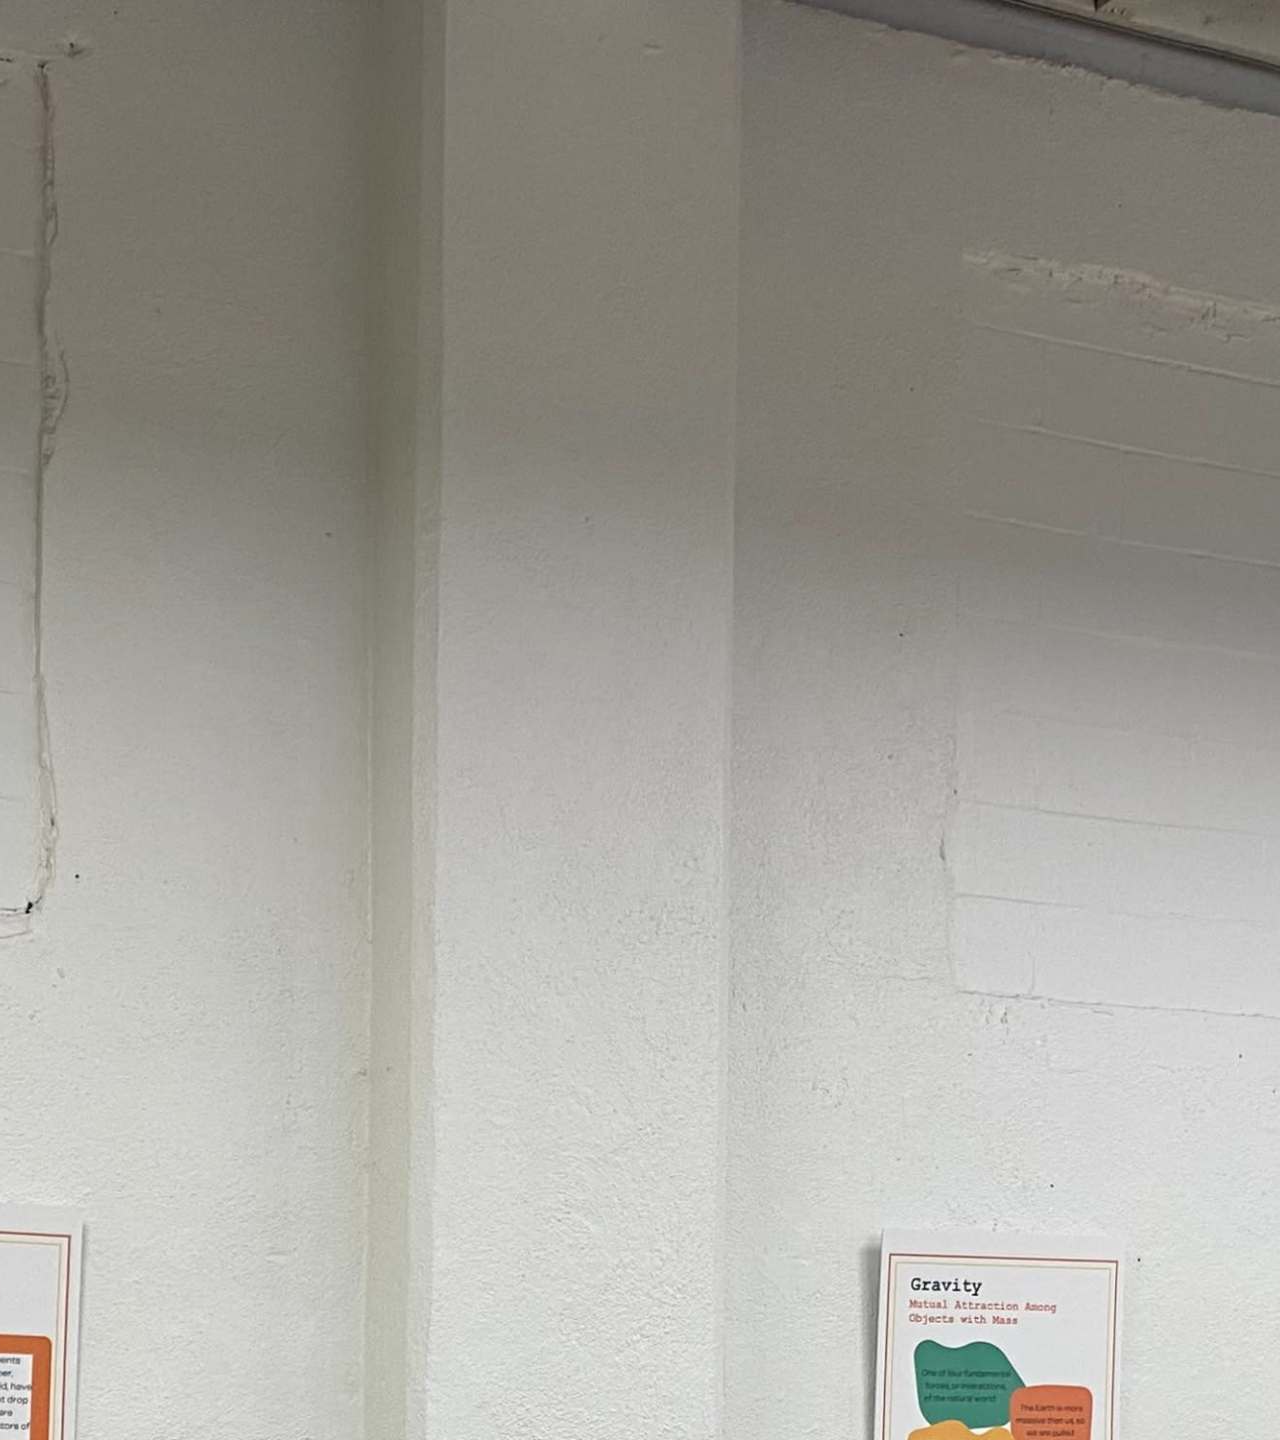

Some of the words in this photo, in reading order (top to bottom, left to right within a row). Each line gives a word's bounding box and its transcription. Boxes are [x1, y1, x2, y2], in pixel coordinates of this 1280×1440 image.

[910, 1277, 982, 1296] Gravity
[909, 1300, 947, 1310] Mutual
[955, 1301, 1019, 1311] Attraction
[1025, 1303, 1057, 1314] Among
[909, 1314, 954, 1324] Objects
[960, 1315, 986, 1324] with
[992, 1316, 1018, 1325] Mass
